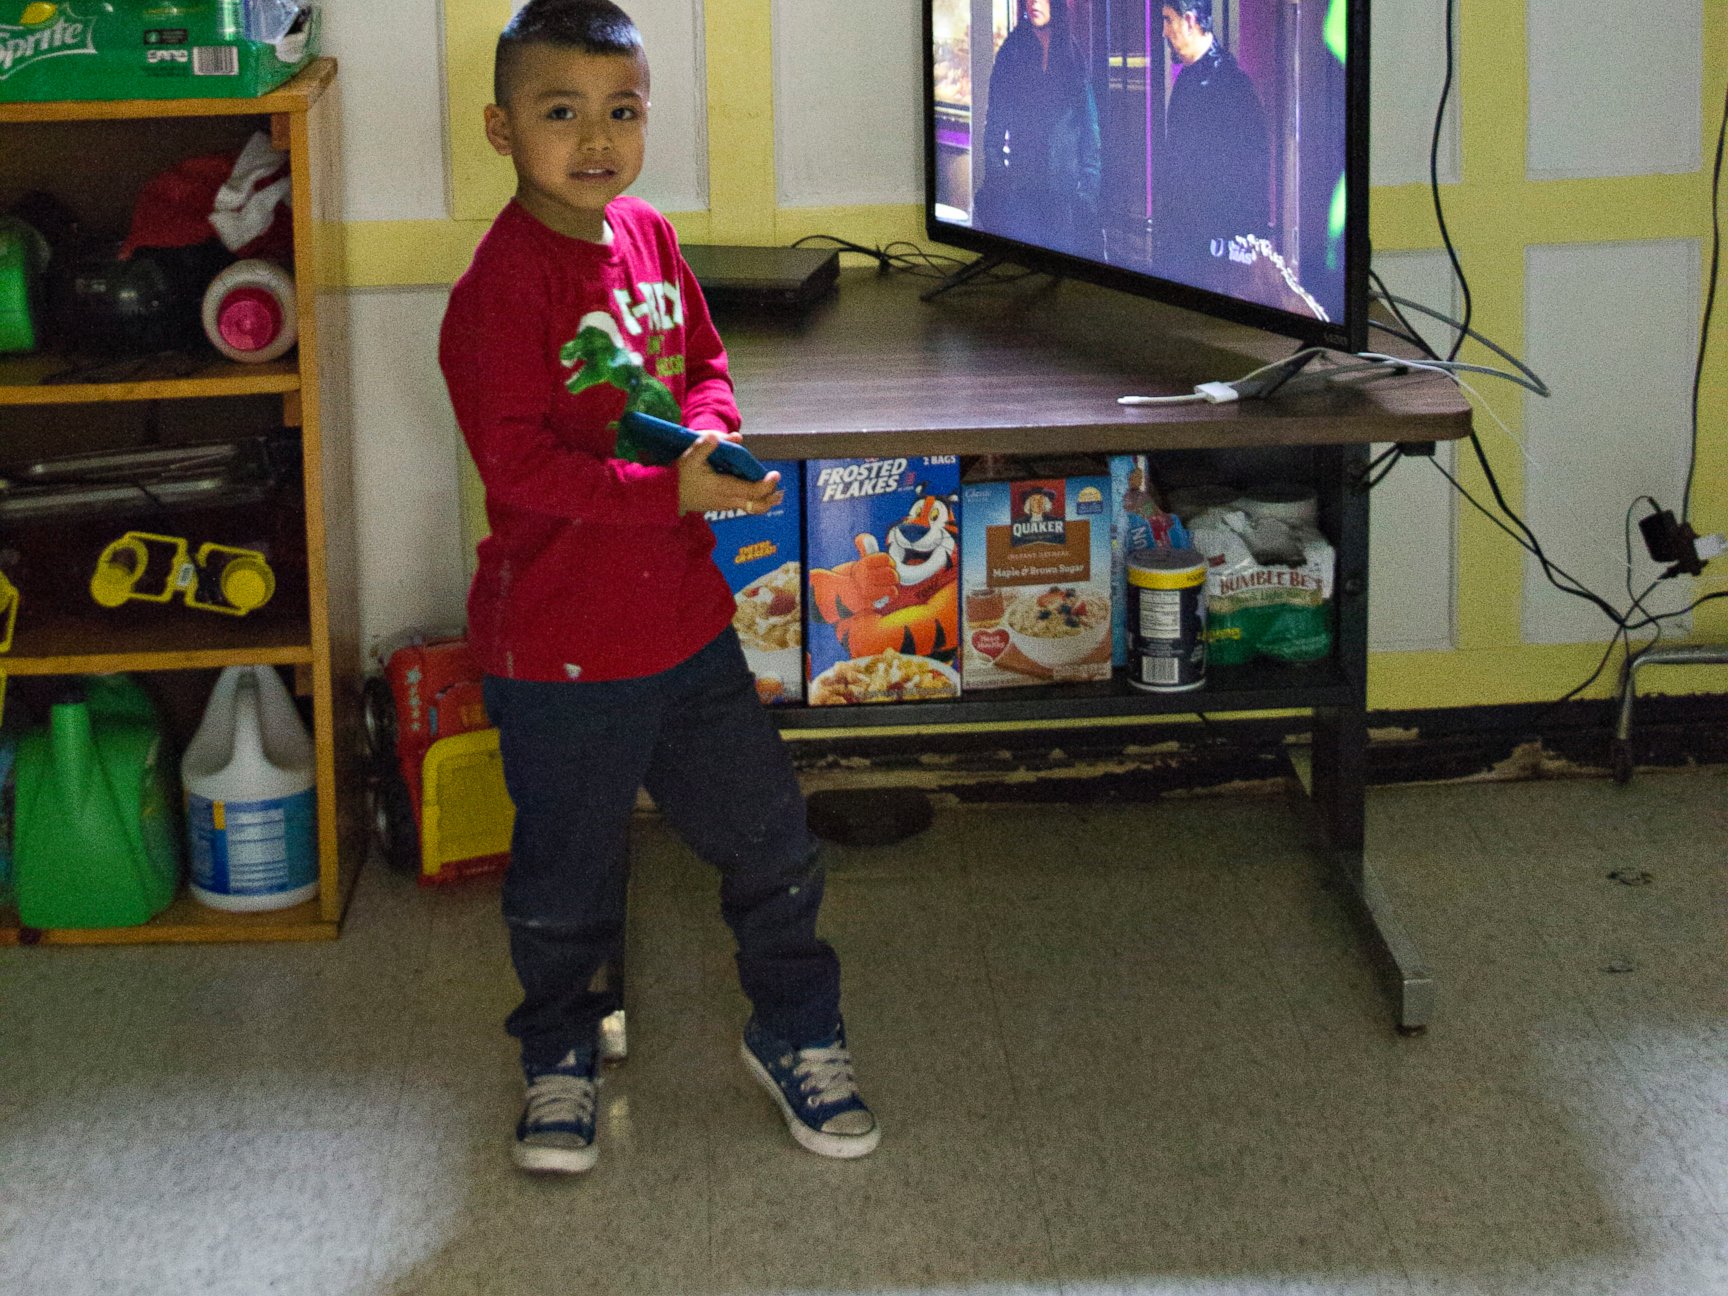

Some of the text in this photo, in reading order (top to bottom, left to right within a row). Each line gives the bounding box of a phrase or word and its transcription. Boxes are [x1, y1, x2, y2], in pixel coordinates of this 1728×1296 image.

[932, 455, 956, 465] BAGS
[817, 458, 908, 487] FROSTED
[822, 474, 901, 502] FLAKES
[1013, 520, 1065, 537] QUAKER
[992, 567, 1020, 578] Maple
[1030, 566, 1058, 576] Brown
[1058, 563, 1084, 574] Sugar
